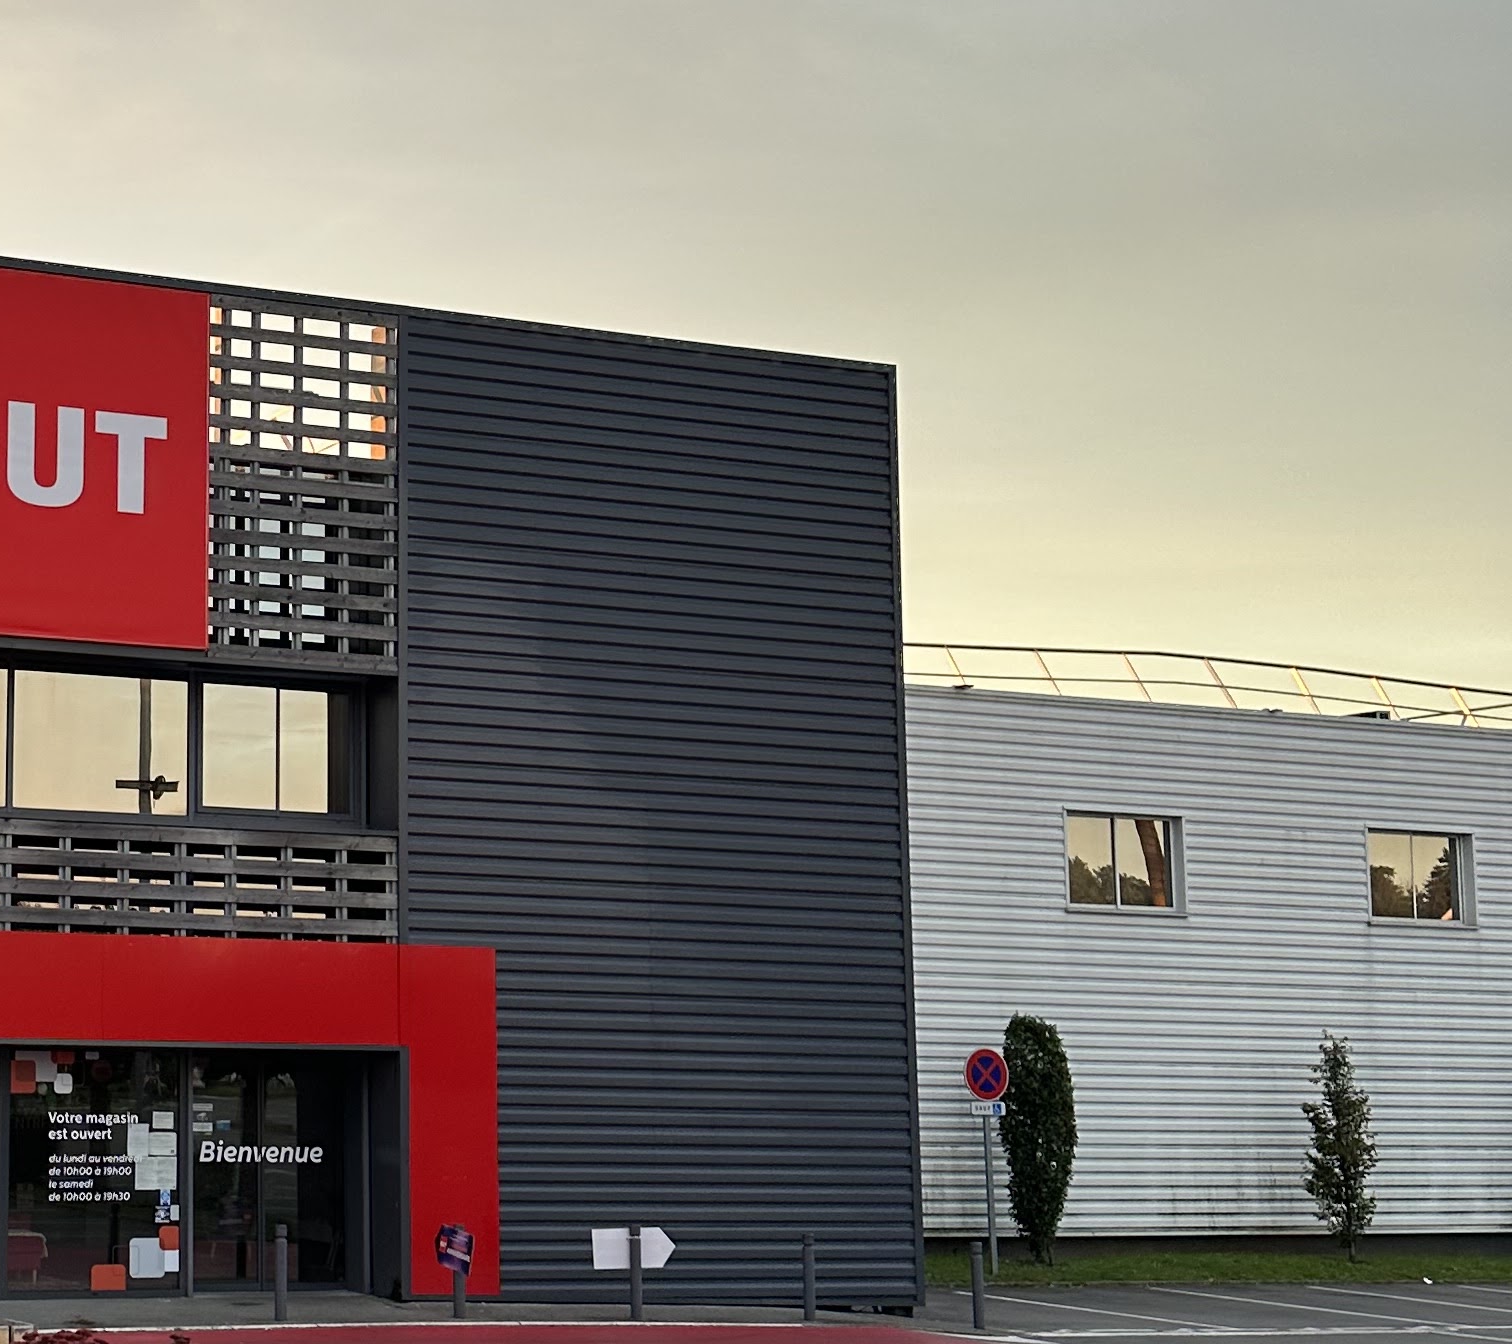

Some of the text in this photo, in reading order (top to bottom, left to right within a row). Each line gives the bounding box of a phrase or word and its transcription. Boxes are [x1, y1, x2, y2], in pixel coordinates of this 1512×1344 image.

[48, 1111, 83, 1124] Votre
[85, 1111, 139, 1127] magasin
[48, 1128, 112, 1140] est ouvert
[199, 1140, 324, 1164] Bienvenue
[48, 1154, 61, 1163] du
[63, 1154, 87, 1163] lundi
[48, 1167, 61, 1176] de
[63, 1166, 93, 1176] 10h00
[103, 1166, 132, 1176] 19h00
[48, 1179, 94, 1189] le samedi
[48, 1192, 61, 1202] de
[63, 1192, 92, 1202] 10h00
[103, 1191, 131, 1202] 19h30
